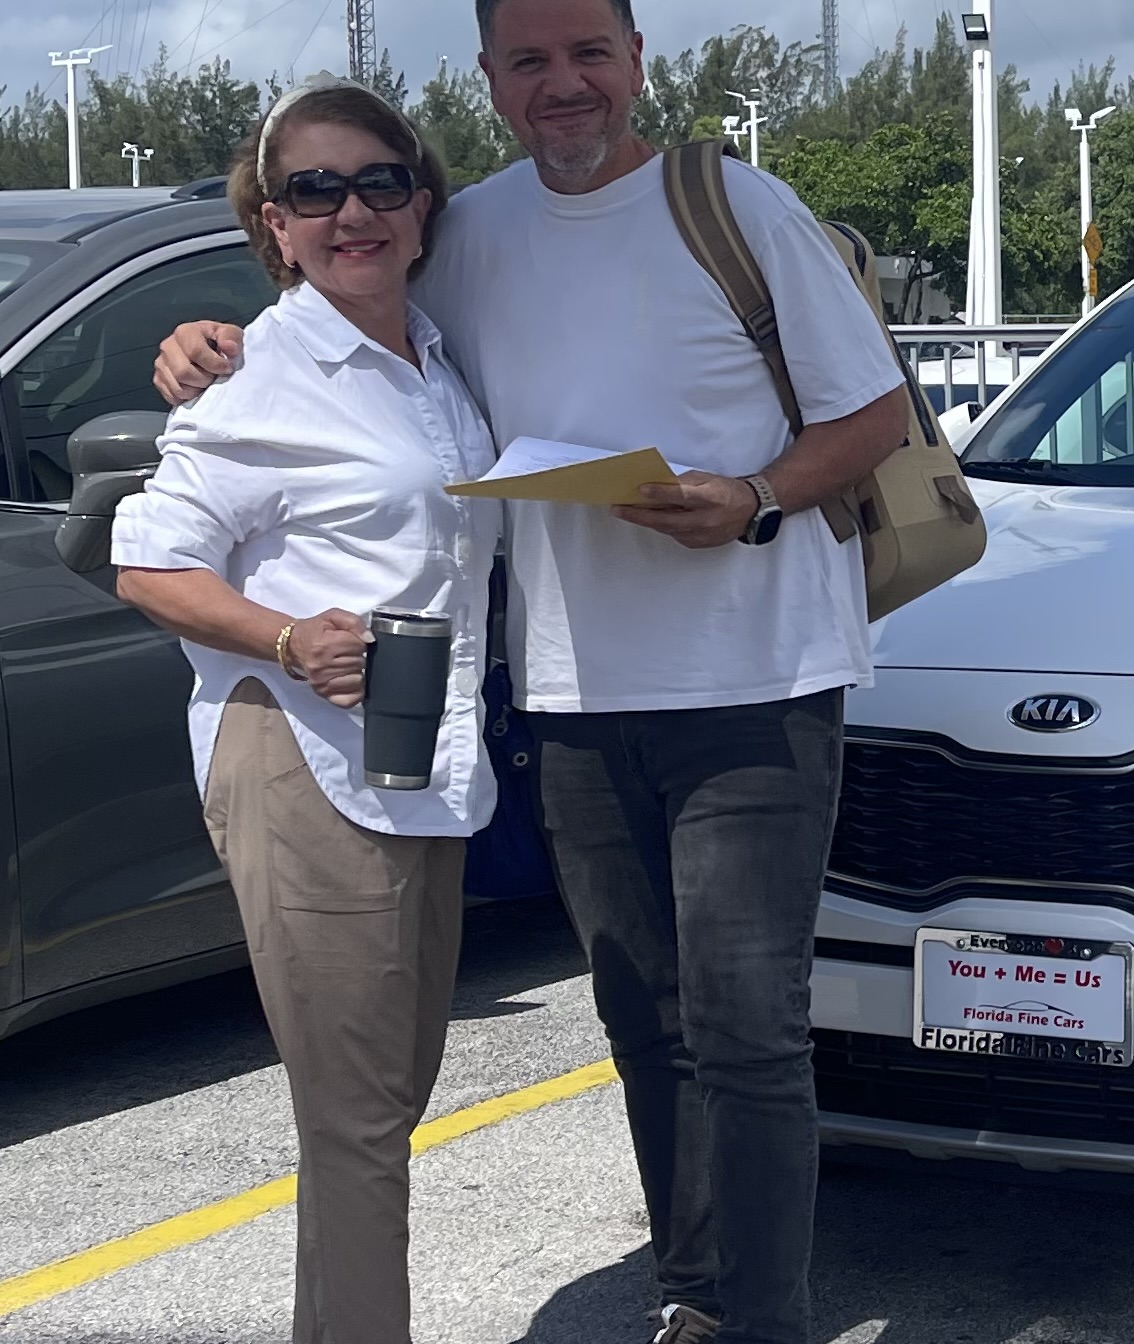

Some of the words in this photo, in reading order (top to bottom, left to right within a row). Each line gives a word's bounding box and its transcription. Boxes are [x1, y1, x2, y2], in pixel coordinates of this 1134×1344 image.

[1020, 698, 1080, 723] KIA
[948, 960, 986, 979] You
[1015, 965, 1046, 983] Me
[1075, 970, 1102, 988] Us
[963, 1008, 1013, 1023] Florida
[1018, 1012, 1049, 1026] Fine
[1053, 1015, 1085, 1029] Cars
[920, 1027, 1004, 1054] Florida
